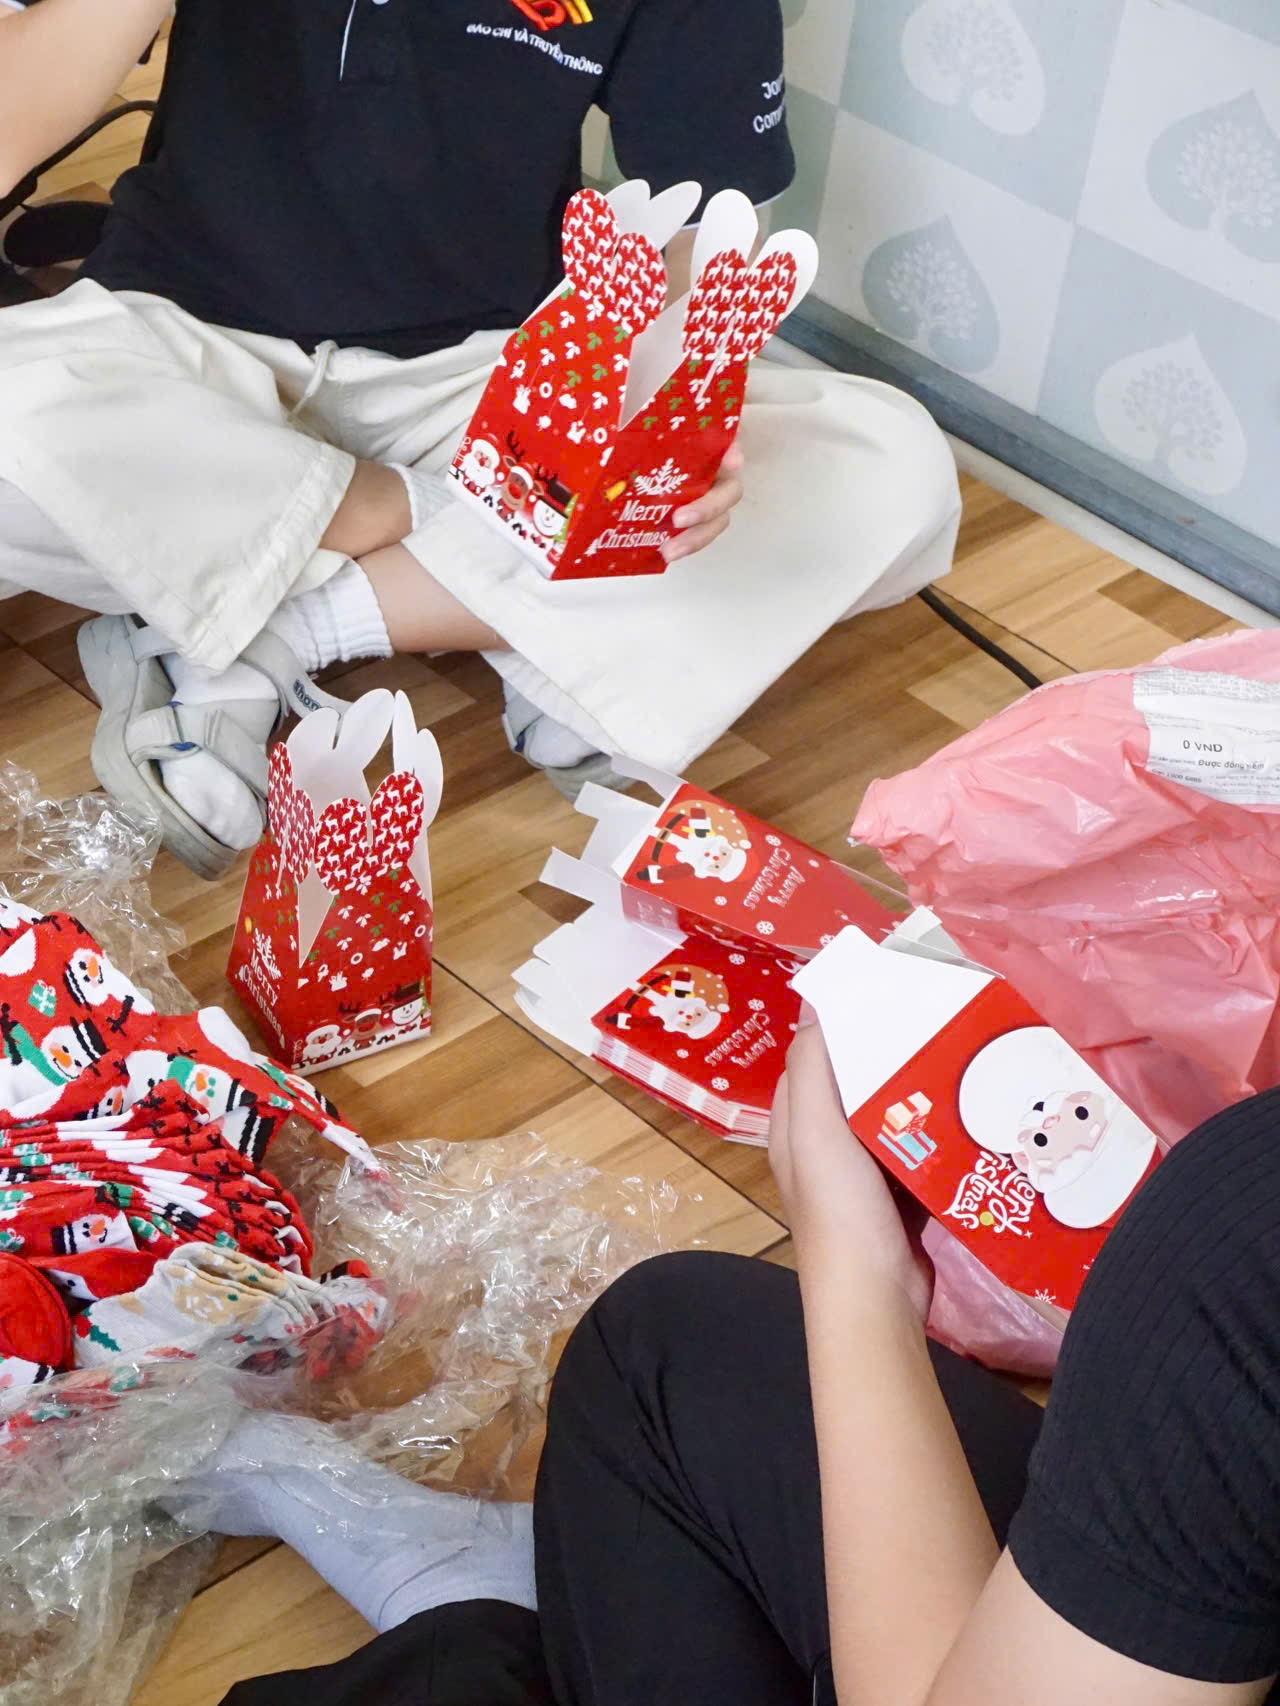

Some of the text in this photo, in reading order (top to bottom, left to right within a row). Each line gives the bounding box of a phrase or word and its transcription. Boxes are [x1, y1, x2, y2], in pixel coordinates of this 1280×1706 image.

[617, 499, 673, 525] Merry
[597, 528, 668, 550] Christmas
[1194, 742, 1223, 753] VND
[251, 949, 278, 1006] Merry
